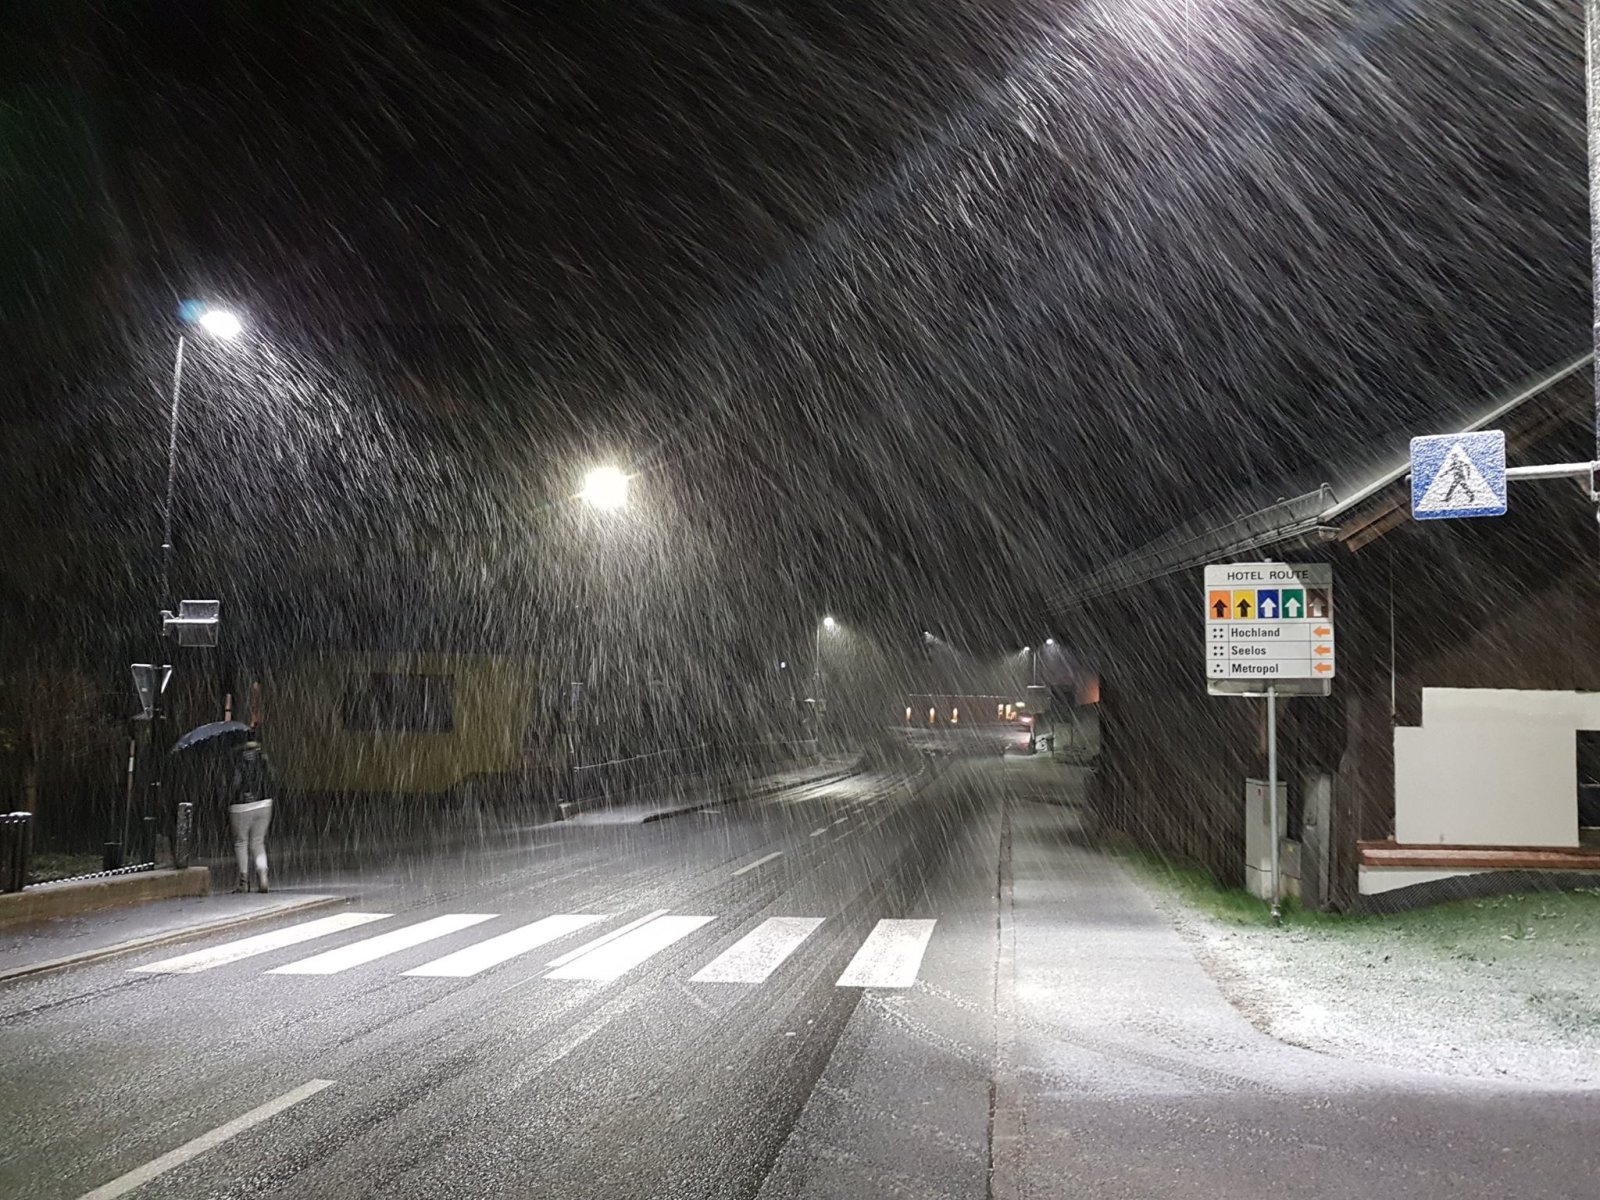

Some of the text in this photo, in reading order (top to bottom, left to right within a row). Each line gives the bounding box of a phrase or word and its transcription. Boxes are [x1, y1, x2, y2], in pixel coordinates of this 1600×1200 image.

[1227, 570, 1309, 581] HOTEL ROUTE
[1231, 627, 1280, 638] Hochland
[1231, 645, 1267, 655] Seelos
[1231, 663, 1279, 675] Metropol
